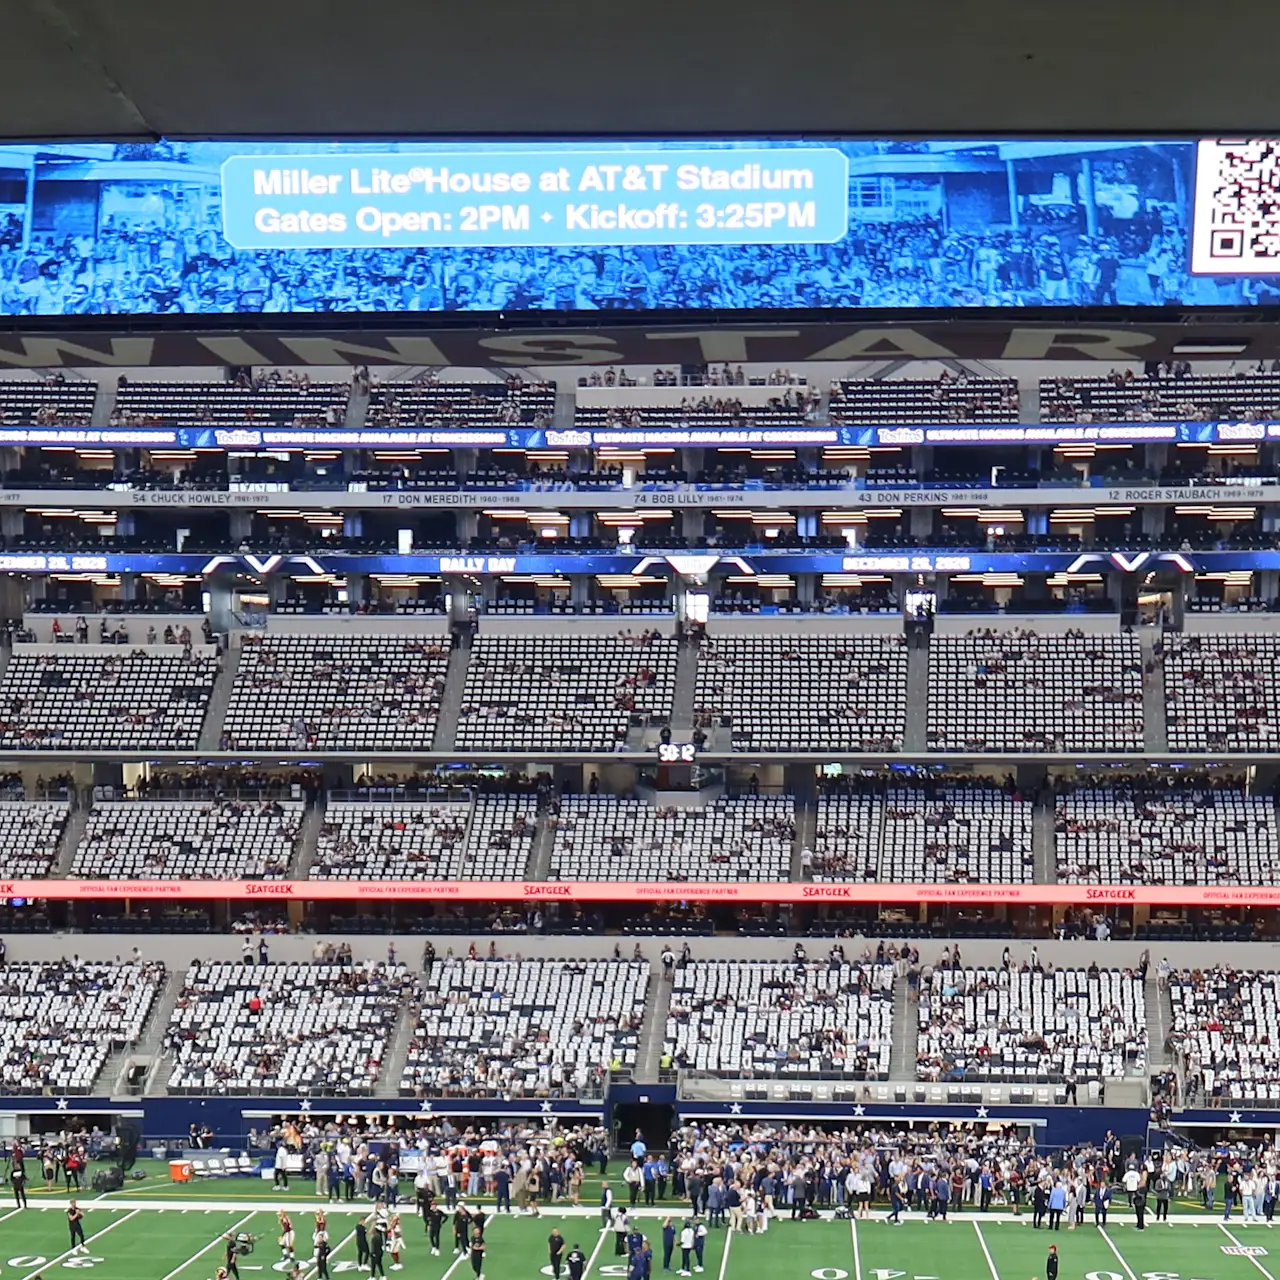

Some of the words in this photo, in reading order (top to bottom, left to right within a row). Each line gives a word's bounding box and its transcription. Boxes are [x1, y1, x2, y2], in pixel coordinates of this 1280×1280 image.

[253, 169, 342, 195] Miller
[538, 168, 570, 191] at
[578, 164, 670, 191] AT&T
[675, 163, 814, 190] Stadium
[254, 206, 348, 233] Gates
[355, 206, 452, 238] Open:
[459, 205, 530, 231] 2PM
[565, 202, 688, 230] Kickoff:
[695, 201, 816, 228] 3:25PM
[879, 428, 923, 443] Tostitos
[1219, 424, 1264, 438] Tostitos
[216, 431, 260, 444] Tostitos
[546, 431, 591, 445] Tostitos
[151, 494, 184, 503] CHUCK
[188, 494, 231, 503] HOWLEY
[399, 495, 420, 503] DON
[424, 495, 476, 504] MEREDITH
[652, 495, 675, 503] BOB
[678, 495, 703, 503] LILLY
[878, 493, 899, 502] DON
[904, 493, 948, 502] PERKINS
[1125, 491, 1161, 500] ROGER
[1166, 490, 1220, 499] STAUBACH
[440, 557, 484, 572] RALLY
[488, 558, 516, 572] DAY
[844, 557, 909, 570] DECEMBER
[246, 885, 293, 895] SEATGEEK
[524, 886, 572, 896] SEATGEEK
[803, 888, 851, 896] SEATGEEK
[1087, 890, 1134, 898] SEATGEEK
